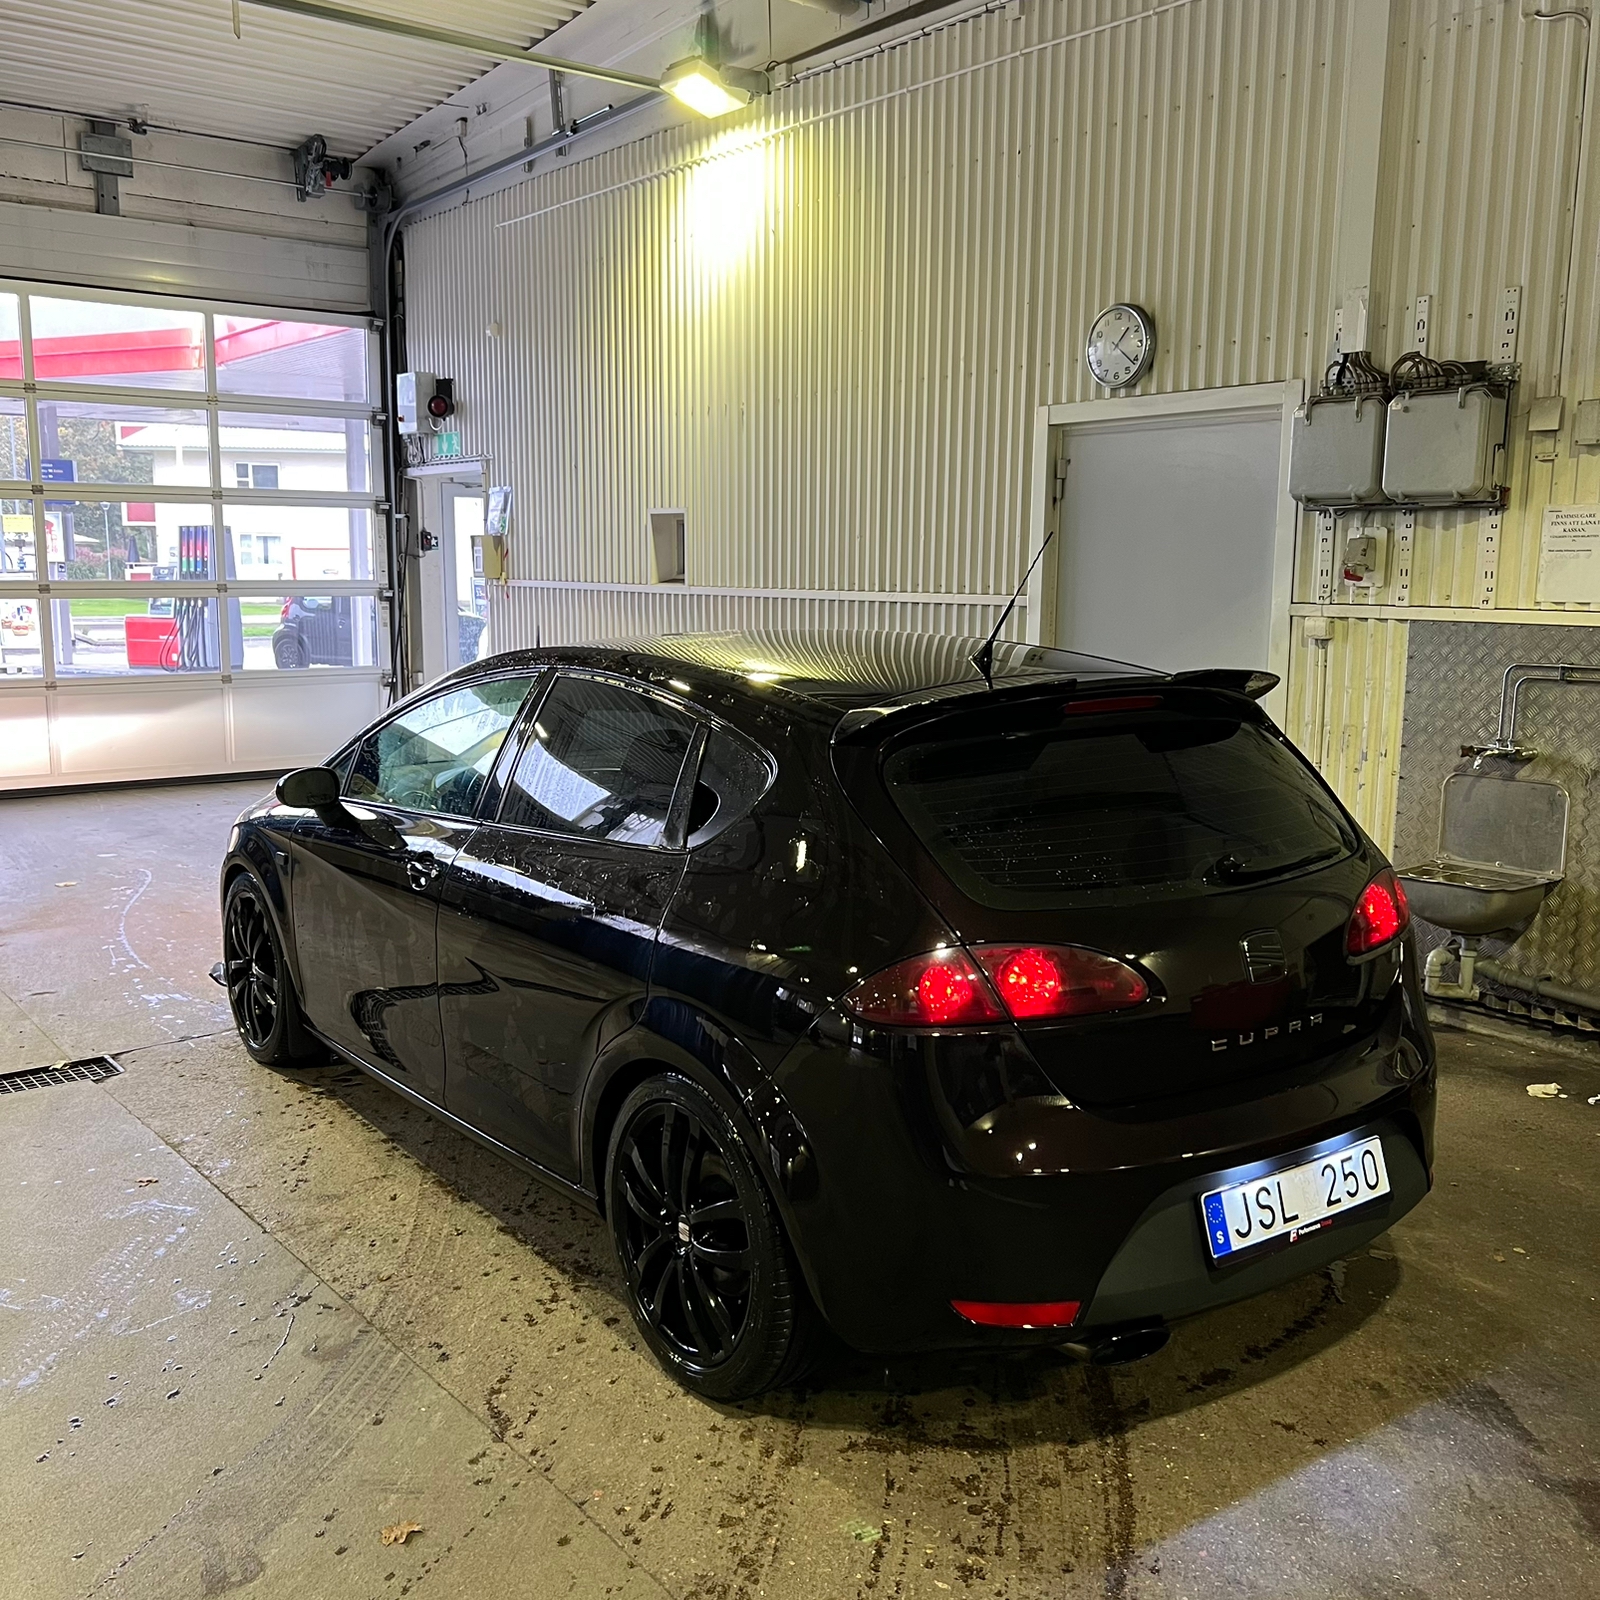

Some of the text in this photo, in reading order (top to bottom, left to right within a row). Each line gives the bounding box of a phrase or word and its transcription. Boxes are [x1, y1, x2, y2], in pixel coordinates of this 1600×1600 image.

[1134, 325, 1140, 333] 2
[1137, 340, 1143, 348] 3
[1133, 354, 1139, 362] 4
[1104, 369, 1109, 377] 7
[1113, 372, 1120, 380] 6
[1211, 1013, 1323, 1051] CUPRA
[1235, 1149, 1379, 1239] JSL 250
[1215, 1230, 1225, 1244] S
